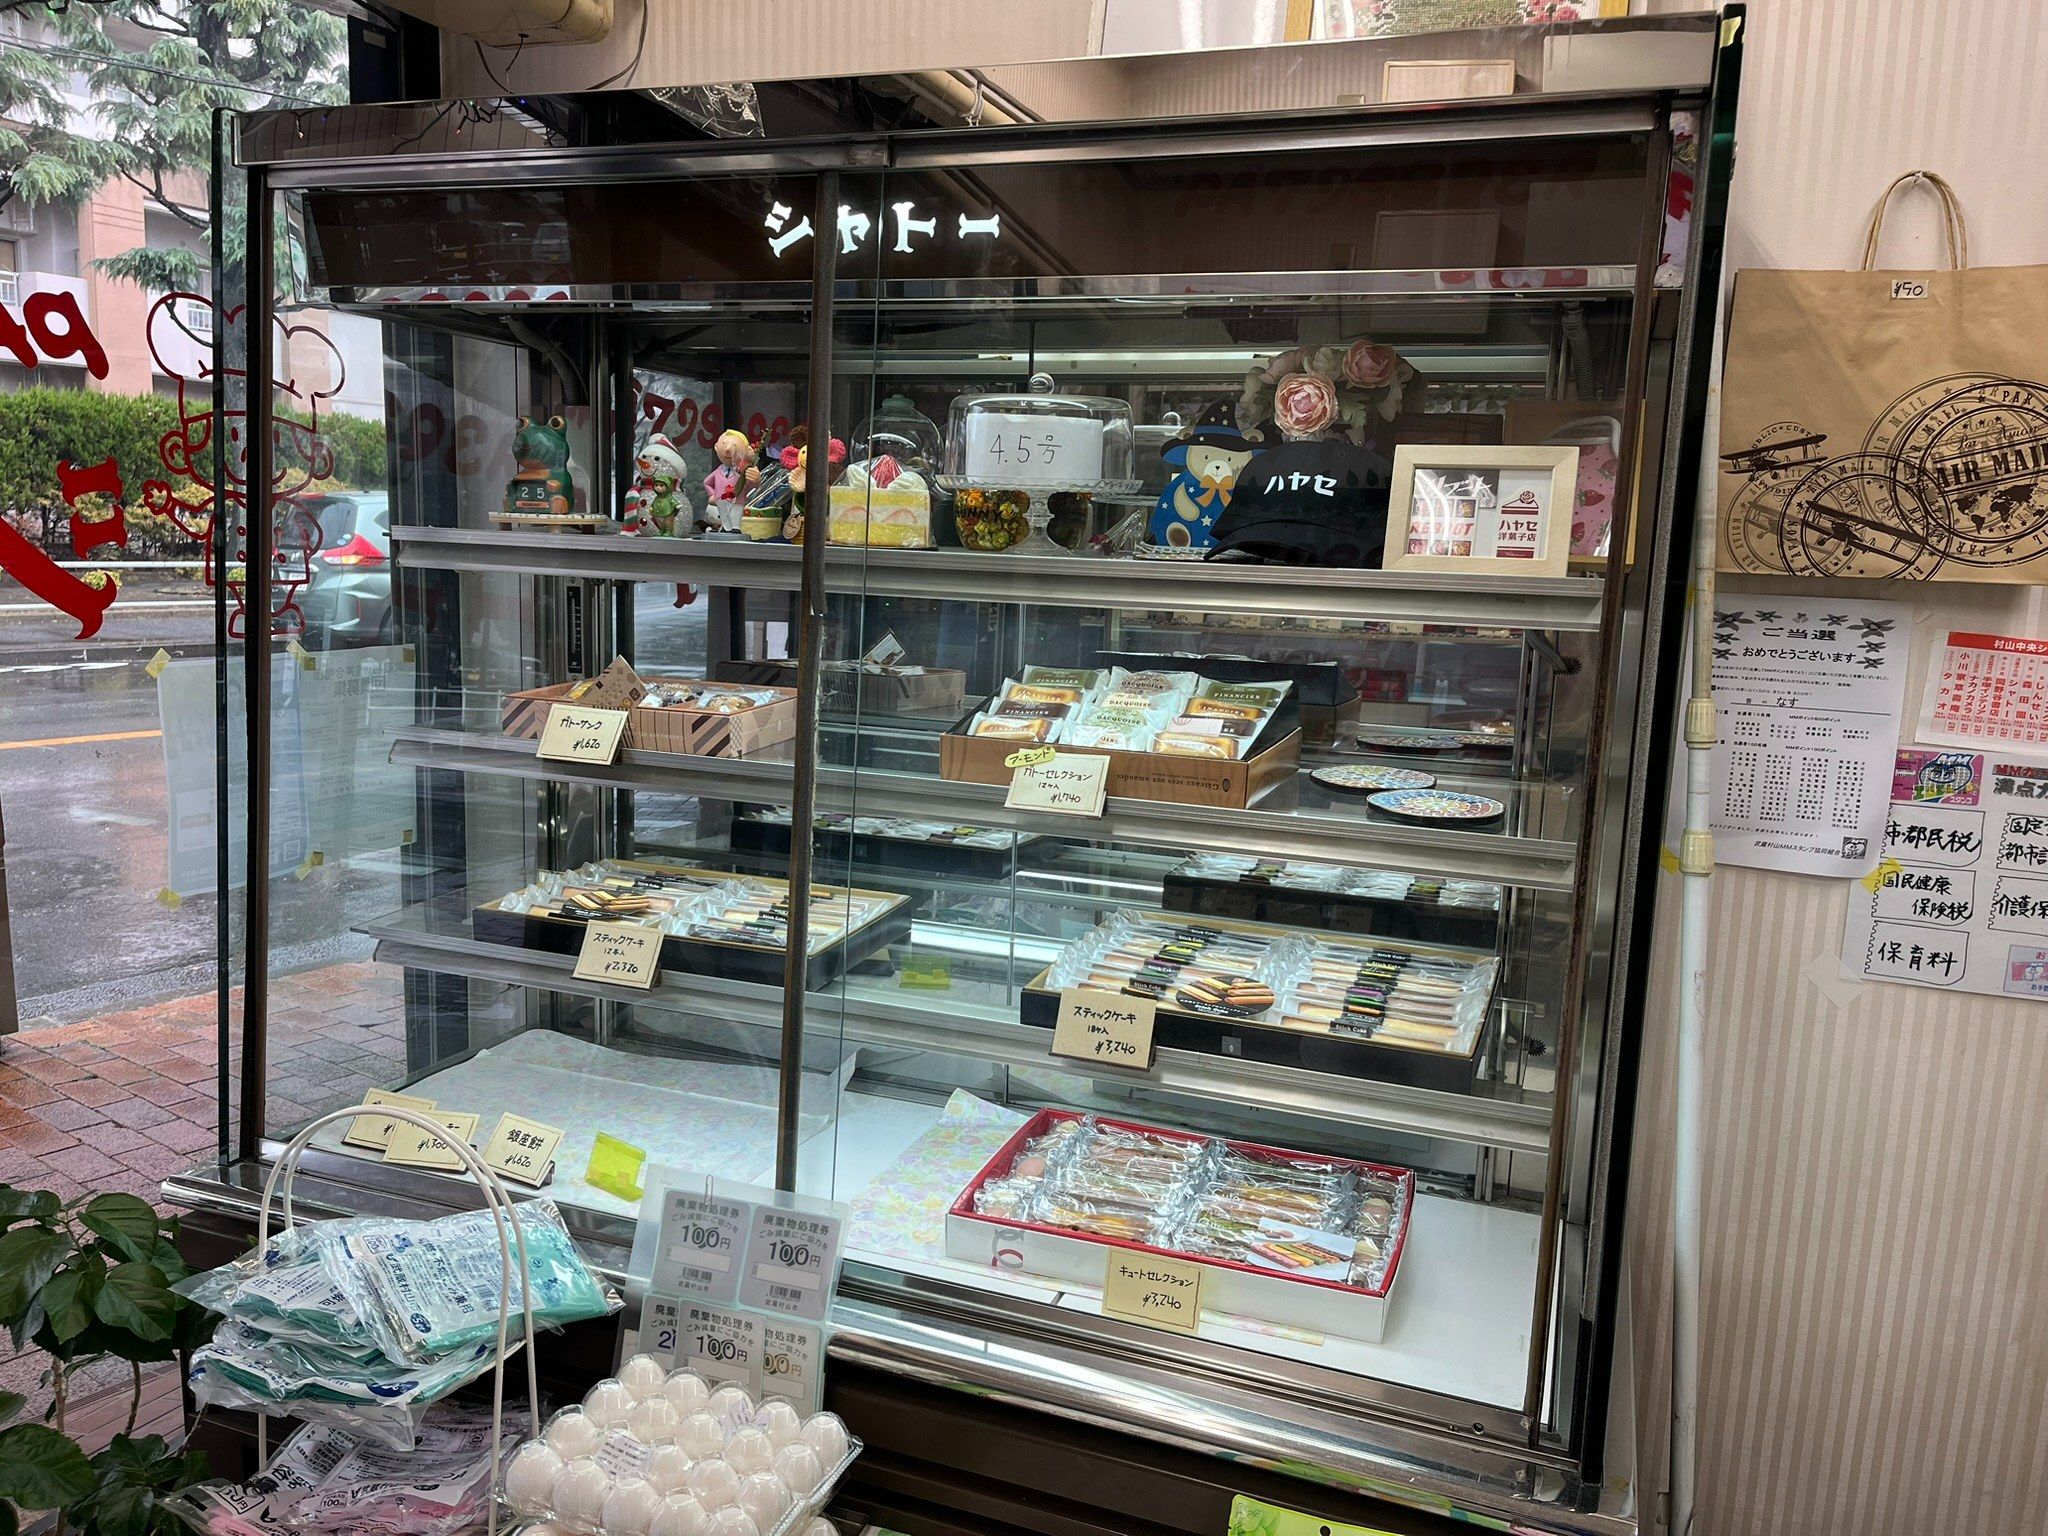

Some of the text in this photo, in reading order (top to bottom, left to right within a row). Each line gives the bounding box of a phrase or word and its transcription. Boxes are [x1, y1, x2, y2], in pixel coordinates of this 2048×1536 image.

[764, 201, 1000, 258] シャトー
[1893, 281, 1924, 298] ¥50
[989, 434, 1063, 464] 4.5号
[1263, 471, 1338, 497] ハヤセ
[1935, 460, 1982, 489] AIR
[1499, 520, 1538, 532] ハヤセ
[1498, 532, 1537, 542] 洋菓子店
[1762, 626, 1837, 641] ご当選
[1742, 646, 1857, 664] おめでとうございます
[1213, 692, 1261, 700] FINANCIER
[1023, 764, 1093, 782] ガトーセレクション
[1050, 793, 1082, 804] ¥1,740
[1882, 870, 1953, 896] 国民健康
[1912, 897, 1974, 921] 保険税
[593, 932, 645, 948] スティックケーキ
[1878, 941, 1958, 977] 保育料
[1073, 1005, 1137, 1025] スティックケーキ
[1094, 1039, 1136, 1056] ¥3,240
[506, 1128, 547, 1152] 銀座餅
[504, 1152, 532, 1168] ¥1,620
[675, 1198, 740, 1219] 廃棄物処理券
[671, 1212, 740, 1234] ごみ減量にご協力を
[763, 1214, 831, 1236] 廃棄物処理券
[682, 1224, 732, 1249] 100円
[758, 1230, 829, 1250] ごみ減量にご協力を
[769, 1241, 822, 1267] 100円
[677, 1280, 710, 1293] 武蔵村山市
[1119, 1265, 1194, 1288] キュートセレクション
[764, 1299, 799, 1312] 武蔵村山市
[1142, 1291, 1182, 1310] ¥3,240
[689, 1308, 754, 1332] 廃棄物処理券
[686, 1324, 755, 1348] ごみ減量にご協力を
[697, 1335, 748, 1362] 100円
